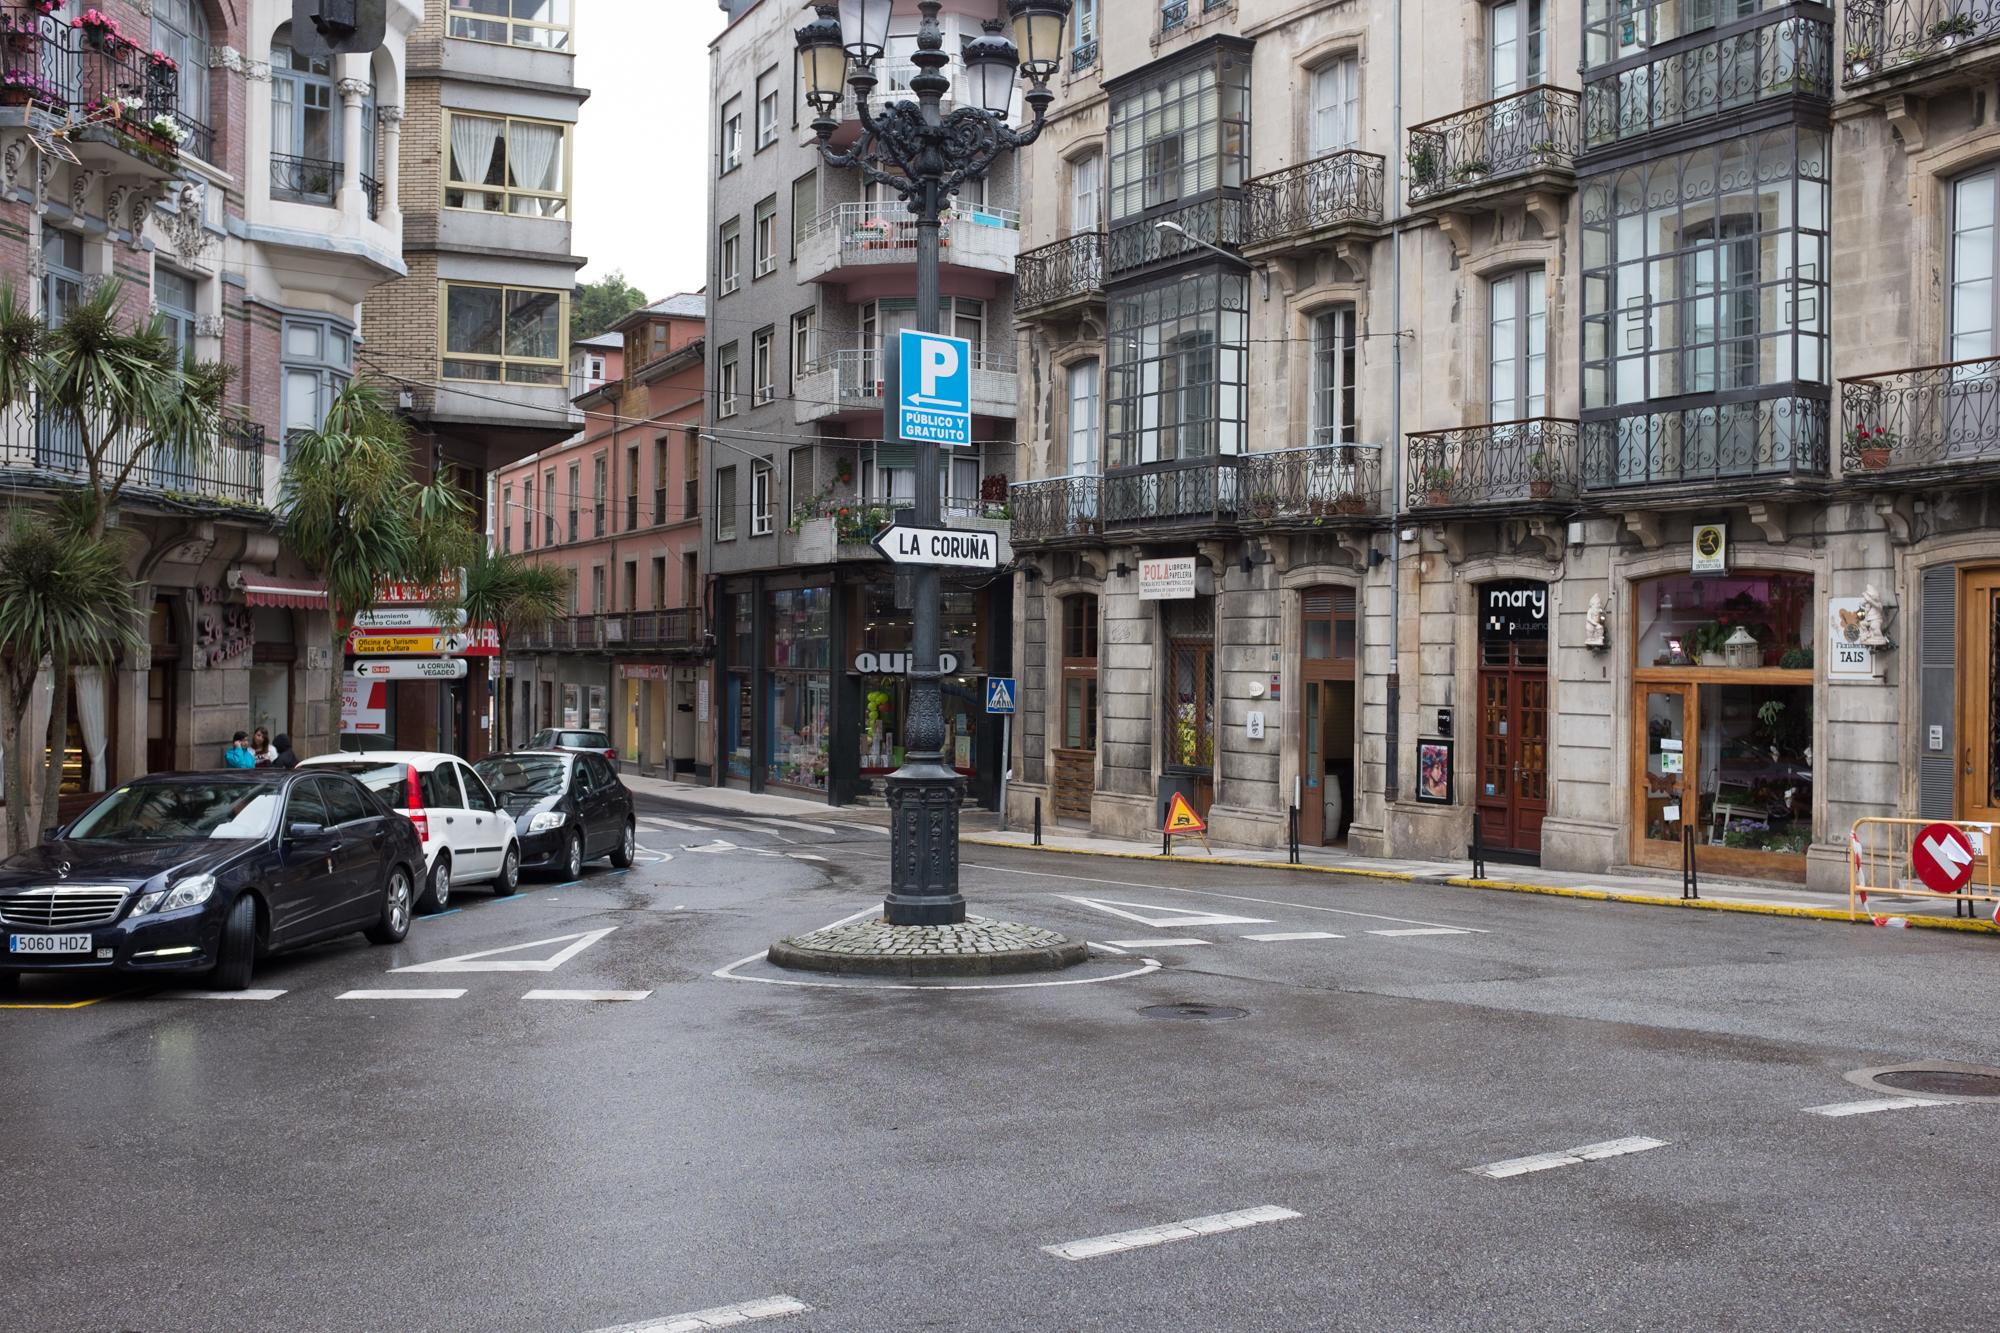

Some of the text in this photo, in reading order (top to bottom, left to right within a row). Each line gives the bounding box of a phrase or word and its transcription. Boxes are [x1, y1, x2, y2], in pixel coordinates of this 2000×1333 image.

[921, 339, 958, 396] P
[905, 411, 965, 429] PÚBLICO Y
[905, 425, 965, 440] GRATUITO
[899, 533, 990, 561] LA CORUÑA
[1144, 564, 1168, 580] POLA
[1490, 590, 1545, 619] mary
[1840, 651, 1864, 663] TAIS
[19, 937, 88, 951] 5060 HDZ
